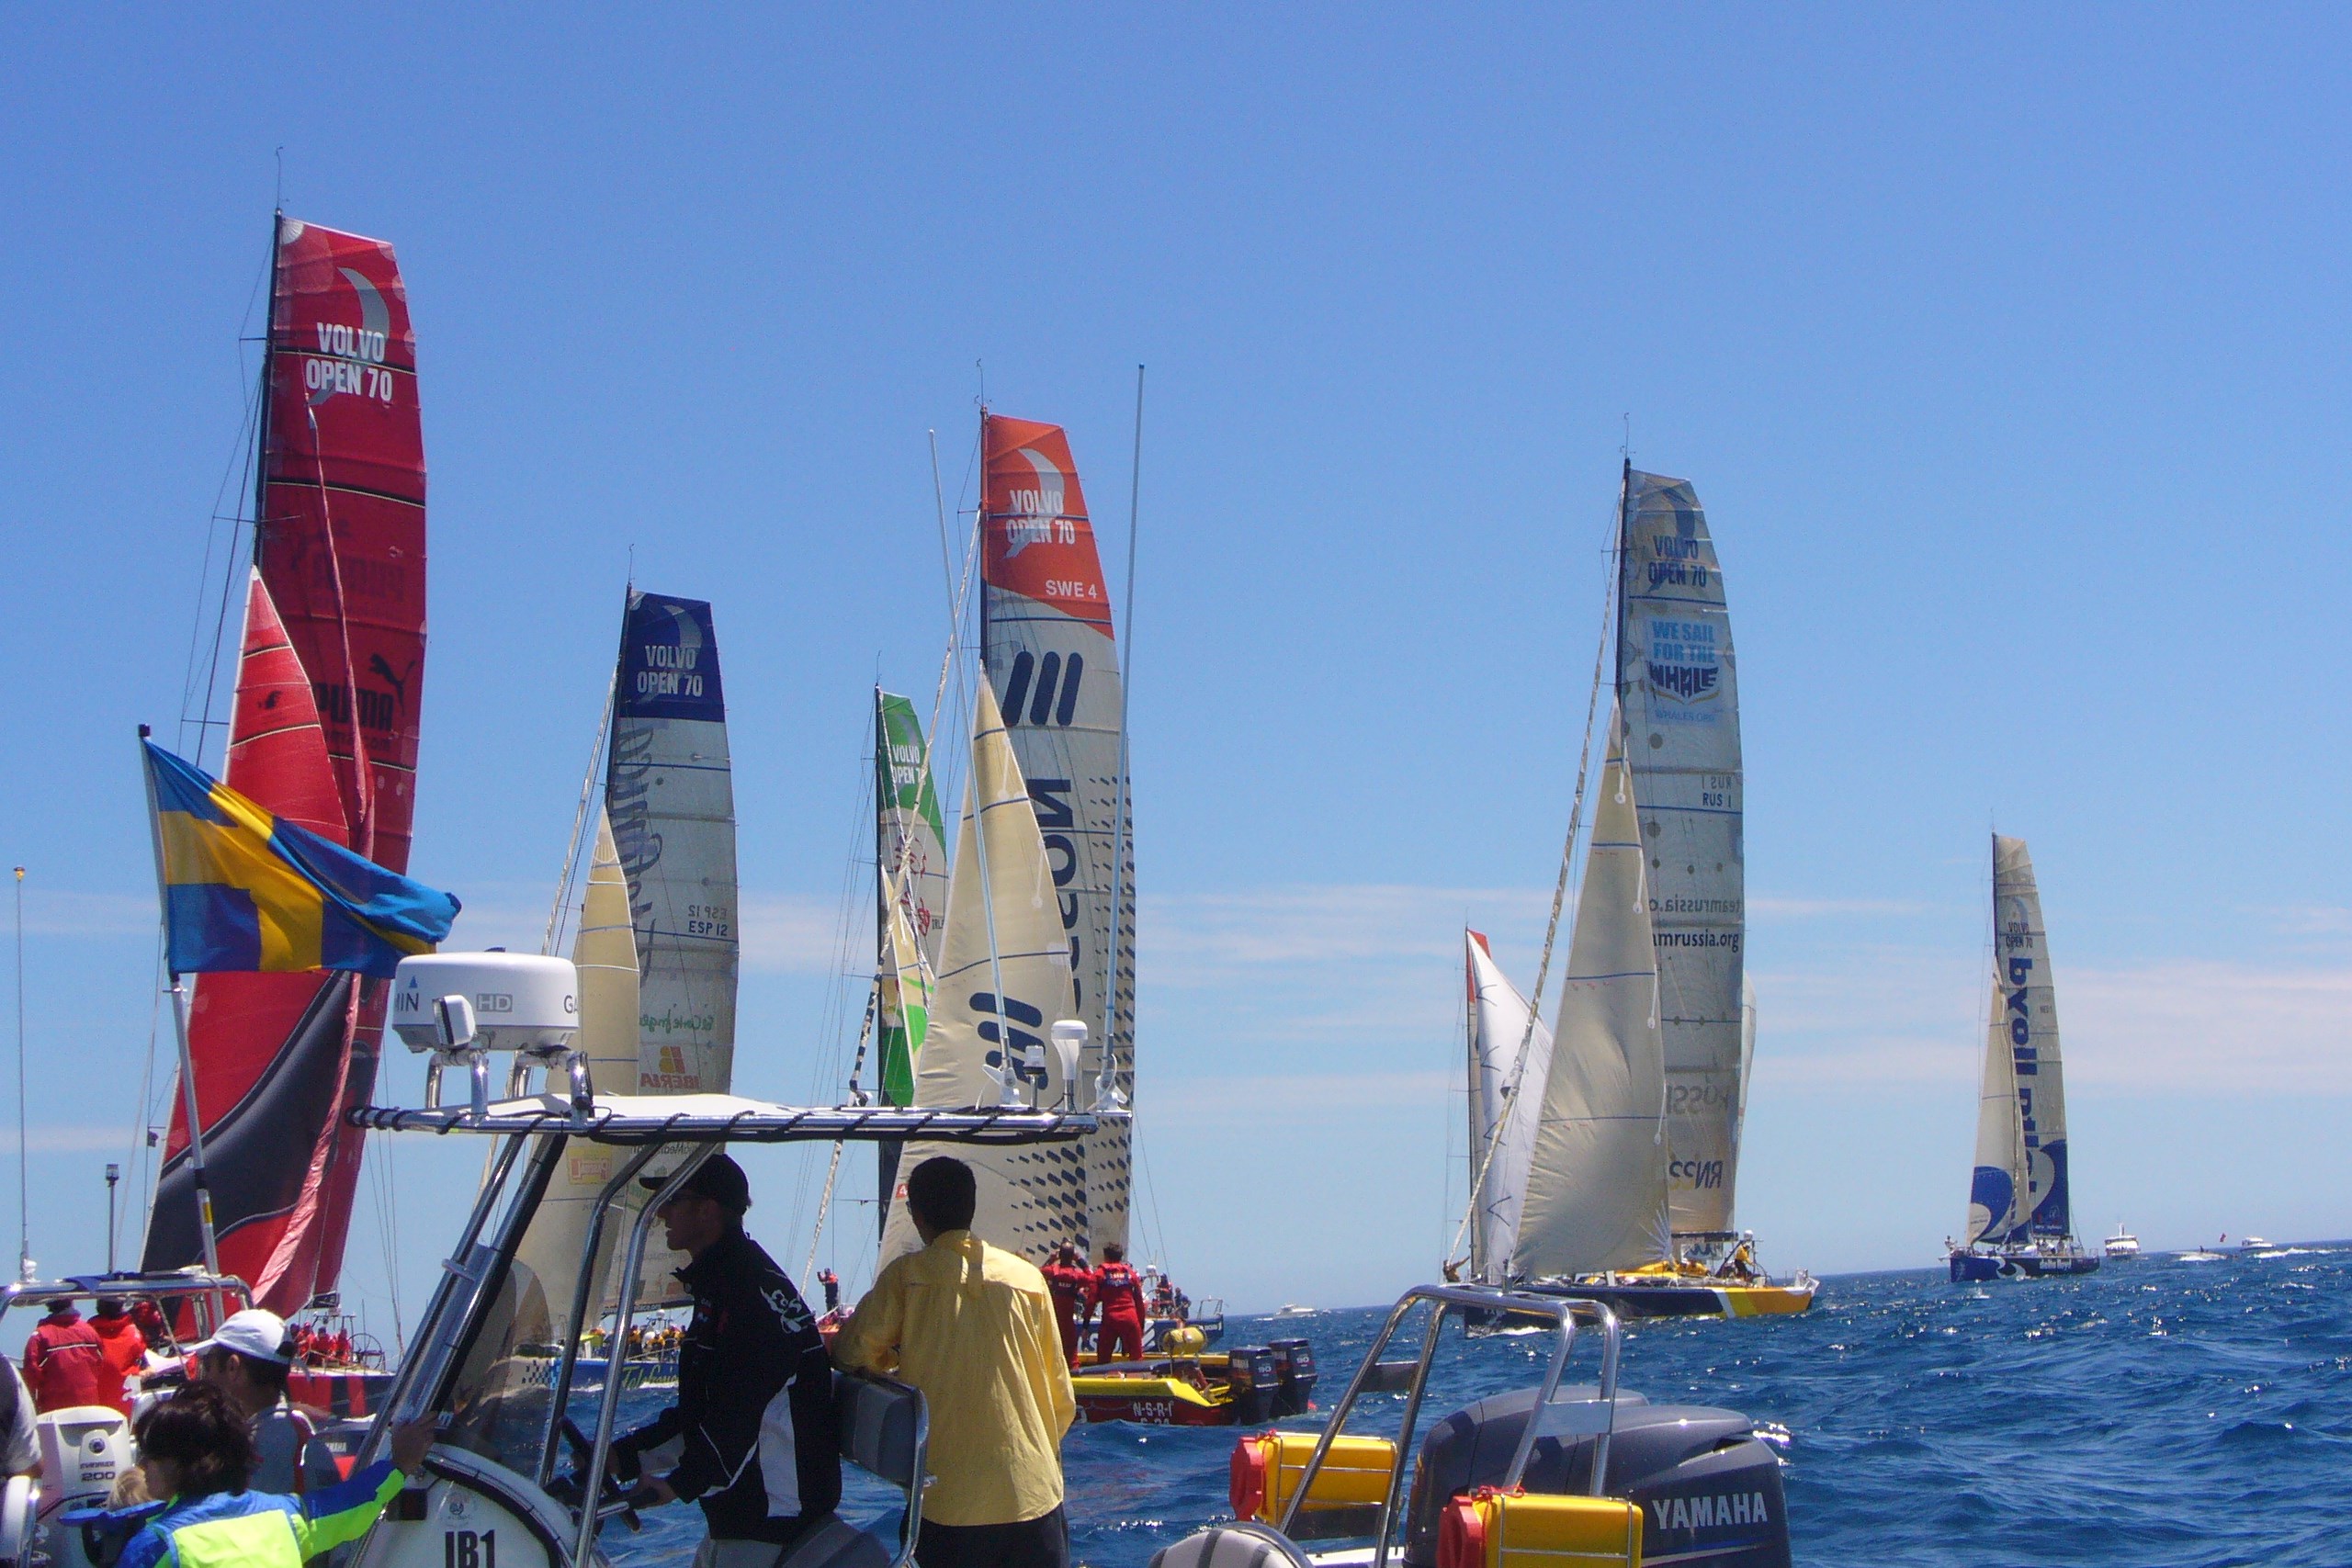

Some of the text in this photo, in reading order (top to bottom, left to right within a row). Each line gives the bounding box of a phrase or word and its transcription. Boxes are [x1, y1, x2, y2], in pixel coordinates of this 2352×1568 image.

[317, 322, 385, 363] VOLVO
[305, 358, 392, 401] OPEN 70
[1010, 490, 1064, 514] VOLVO
[1006, 519, 1076, 545] OPEN 70
[1653, 536, 1699, 558] VOLVO
[1648, 561, 1707, 587] OPEN 70
[1046, 580, 1097, 599] SWE 4
[1652, 621, 1714, 643] WE SAIL
[645, 645, 696, 670] VOLVO
[1654, 642, 1684, 660] FOR
[637, 671, 703, 697] OPEN 70
[893, 744, 920, 763] VOLVO
[1702, 793, 1723, 807] RUS
[689, 920, 728, 937] ESP 12
[477, 994, 512, 1011] HD
[81, 1472, 116, 1482] 200
[1652, 1492, 1768, 1529] YAMAHA
